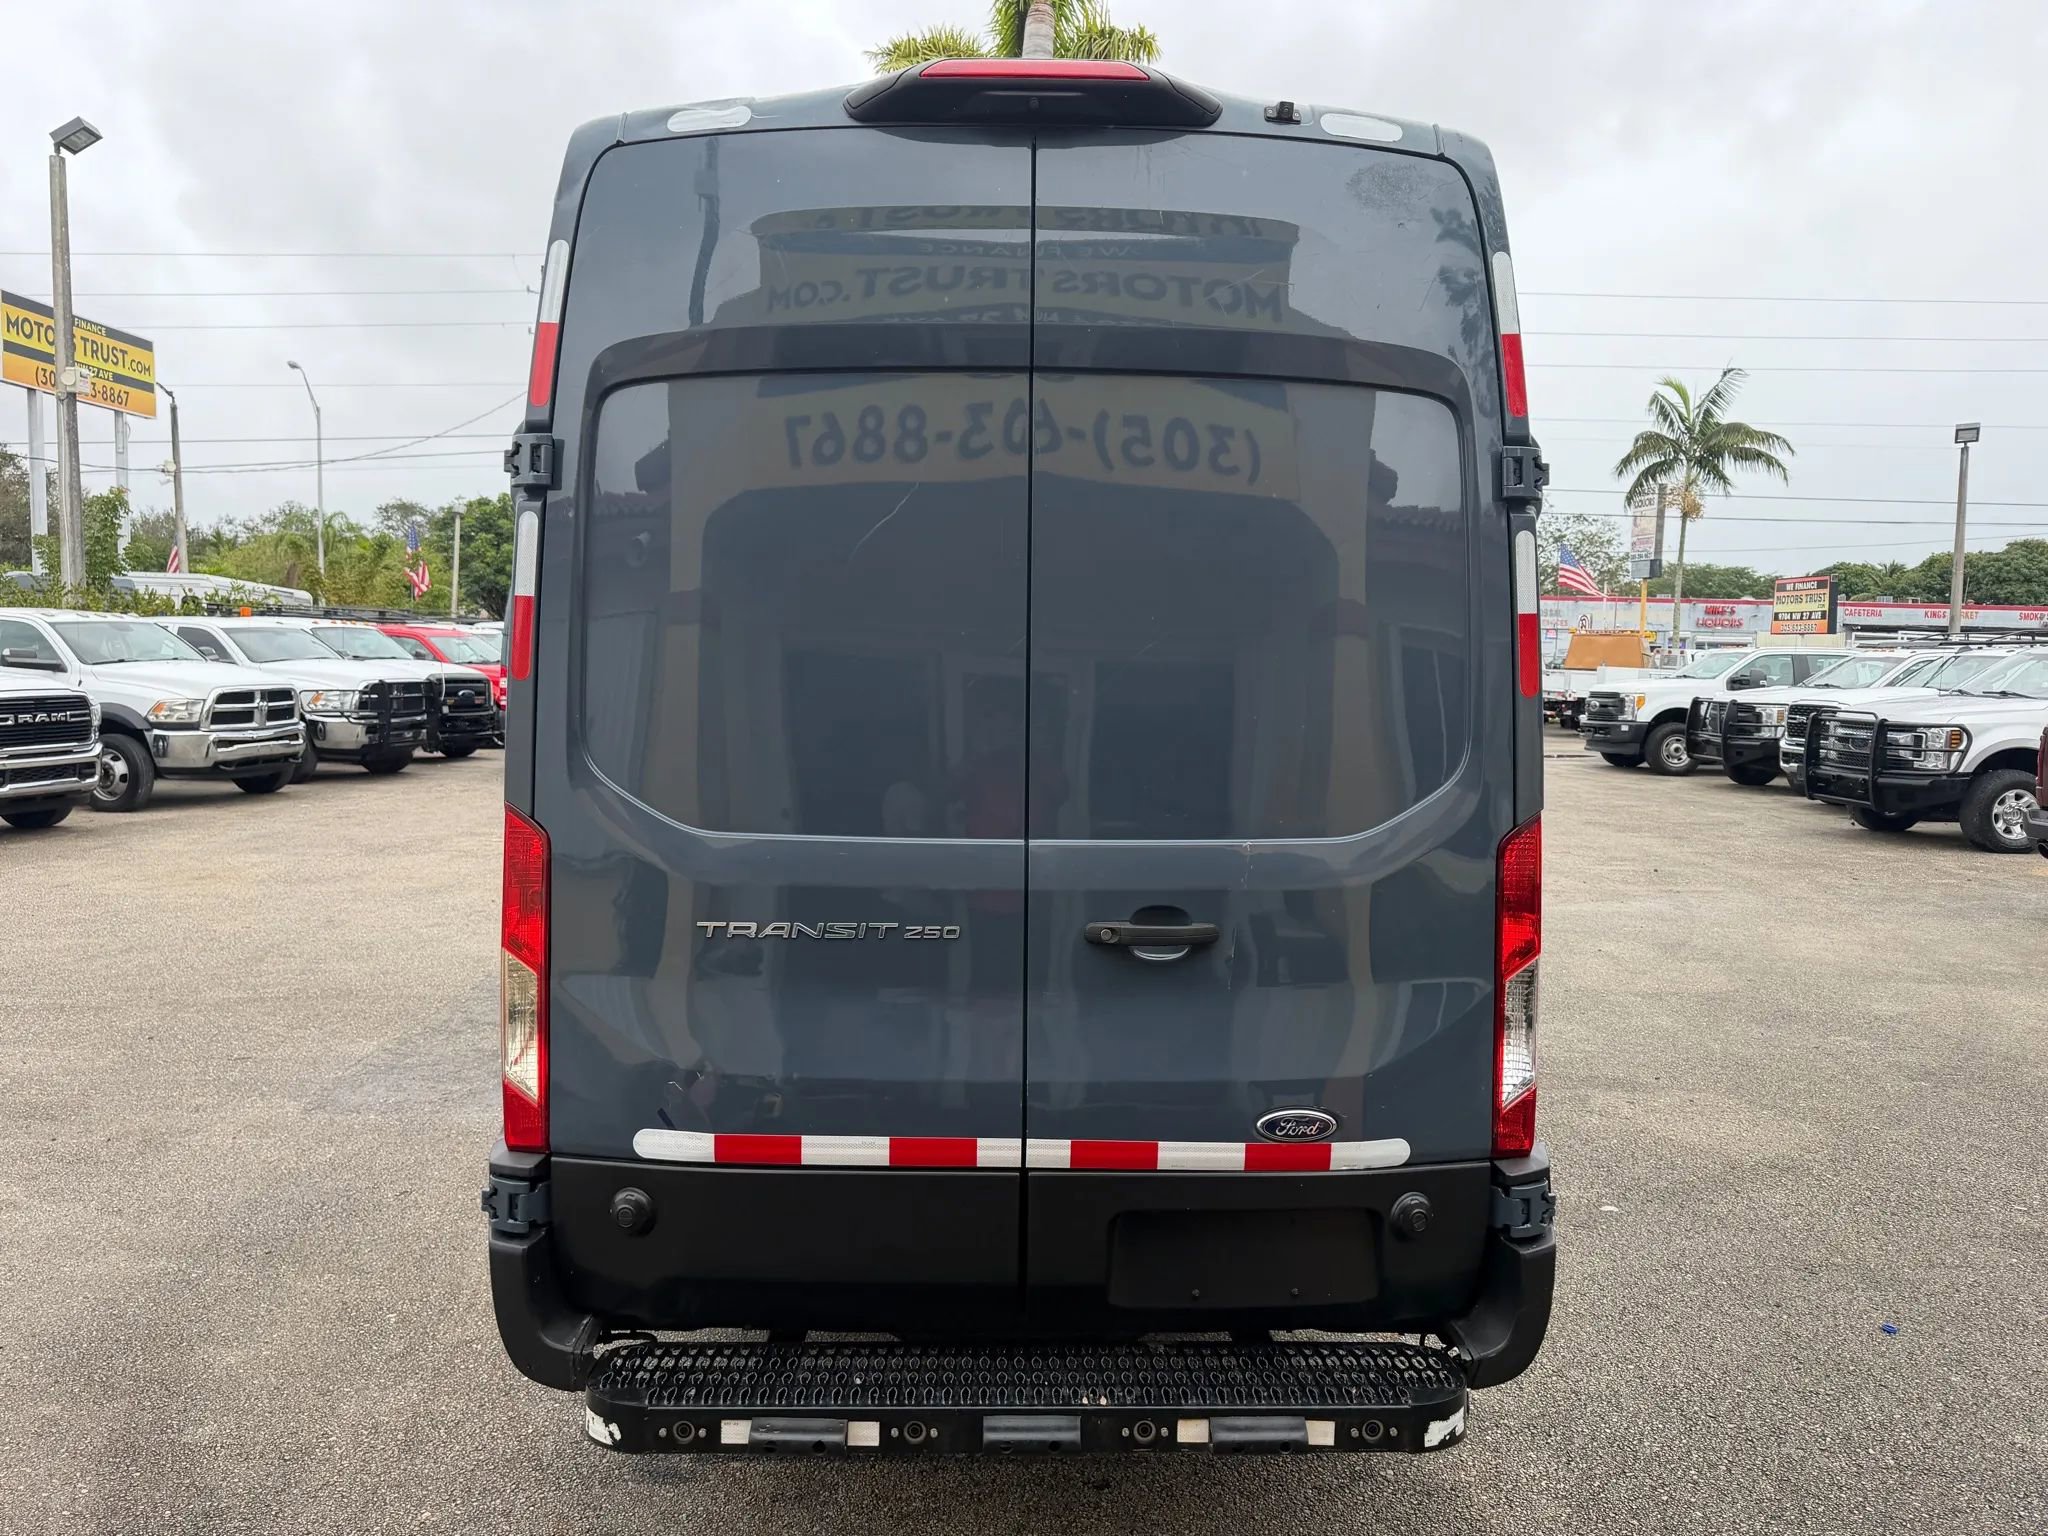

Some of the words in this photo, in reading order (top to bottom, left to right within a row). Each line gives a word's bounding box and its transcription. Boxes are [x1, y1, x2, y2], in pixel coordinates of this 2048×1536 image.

[6, 312, 77, 351] MOTO
[75, 317, 107, 336] FINANCE
[99, 369, 114, 381] AVE
[1795, 581, 1818, 590] FINANCE
[1776, 594, 1803, 605] MOTORS
[1805, 592, 1827, 604] TRUST
[1844, 608, 1882, 617] CAFETERIA
[1924, 610, 1947, 619] KINGS
[17, 712, 66, 723] RAM
[696, 921, 899, 939] TRANSIT
[903, 925, 961, 939] 250
[1275, 1116, 1321, 1136] Ford
